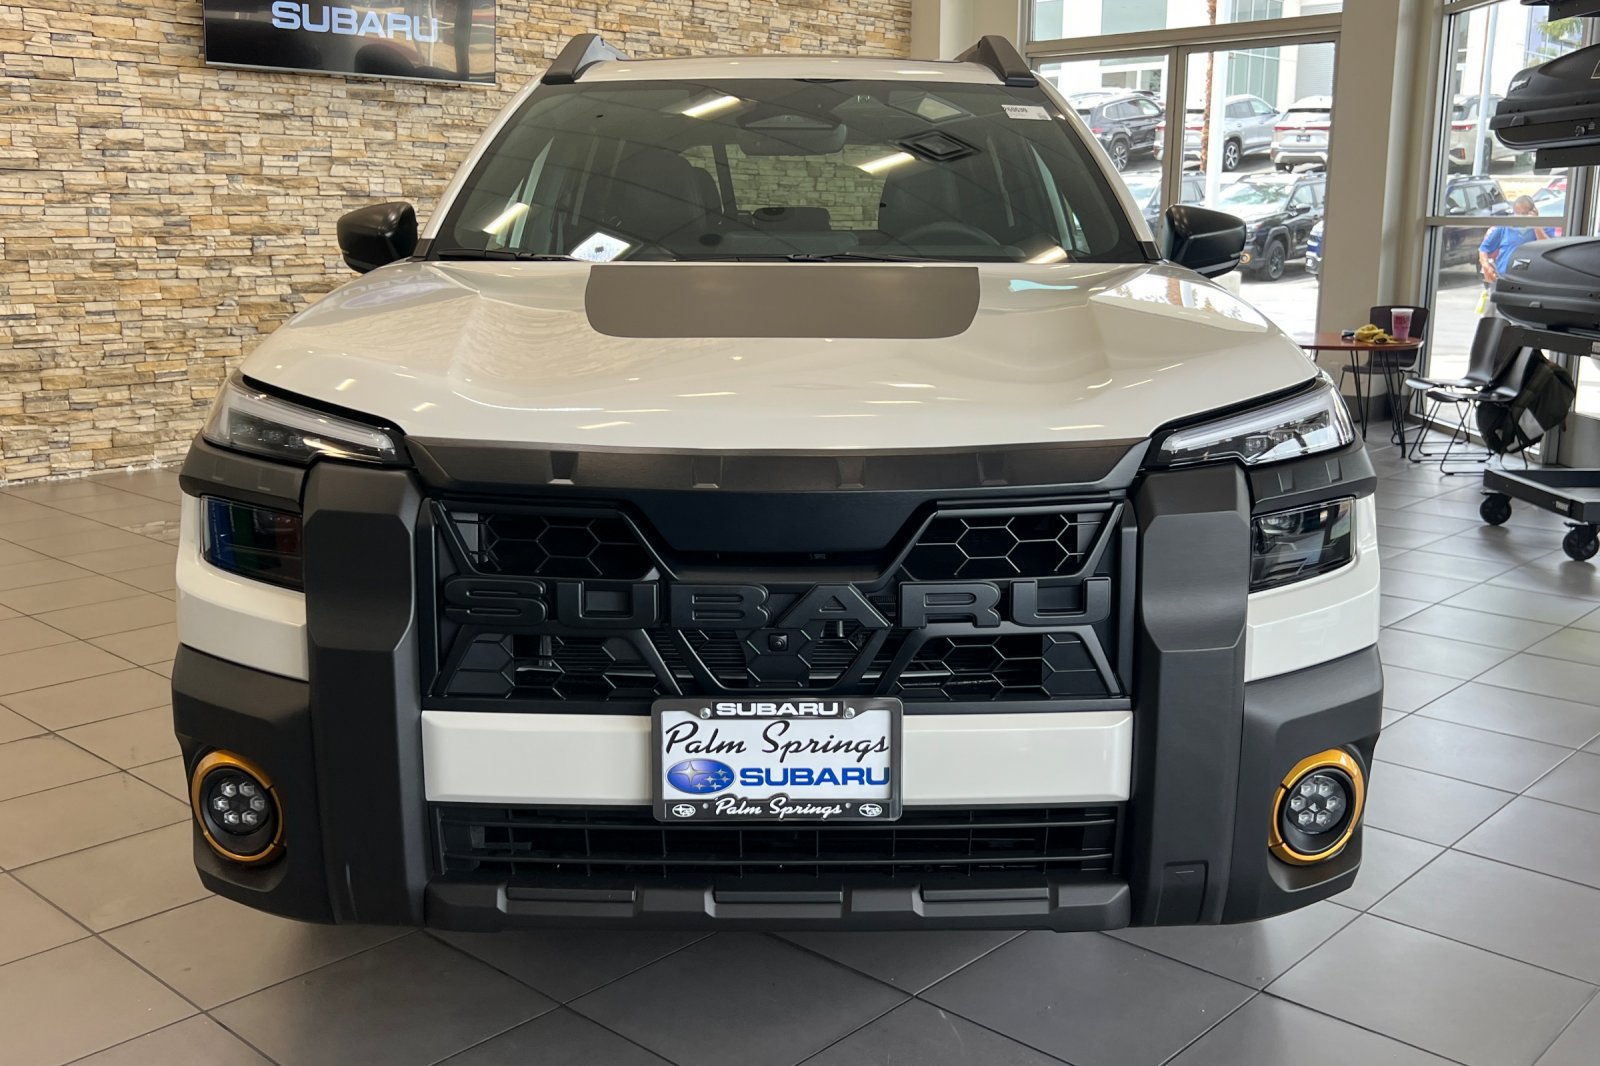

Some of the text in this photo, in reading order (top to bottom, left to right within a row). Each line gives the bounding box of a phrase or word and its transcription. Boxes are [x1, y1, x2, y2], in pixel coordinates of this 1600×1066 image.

[271, 0, 439, 43] SUBARU
[443, 576, 1111, 629] SUBARU
[716, 702, 839, 716] SUBARU
[665, 720, 890, 763] Palm Springs
[739, 767, 890, 786] SUBARU
[714, 797, 842, 820] Palm Springs
